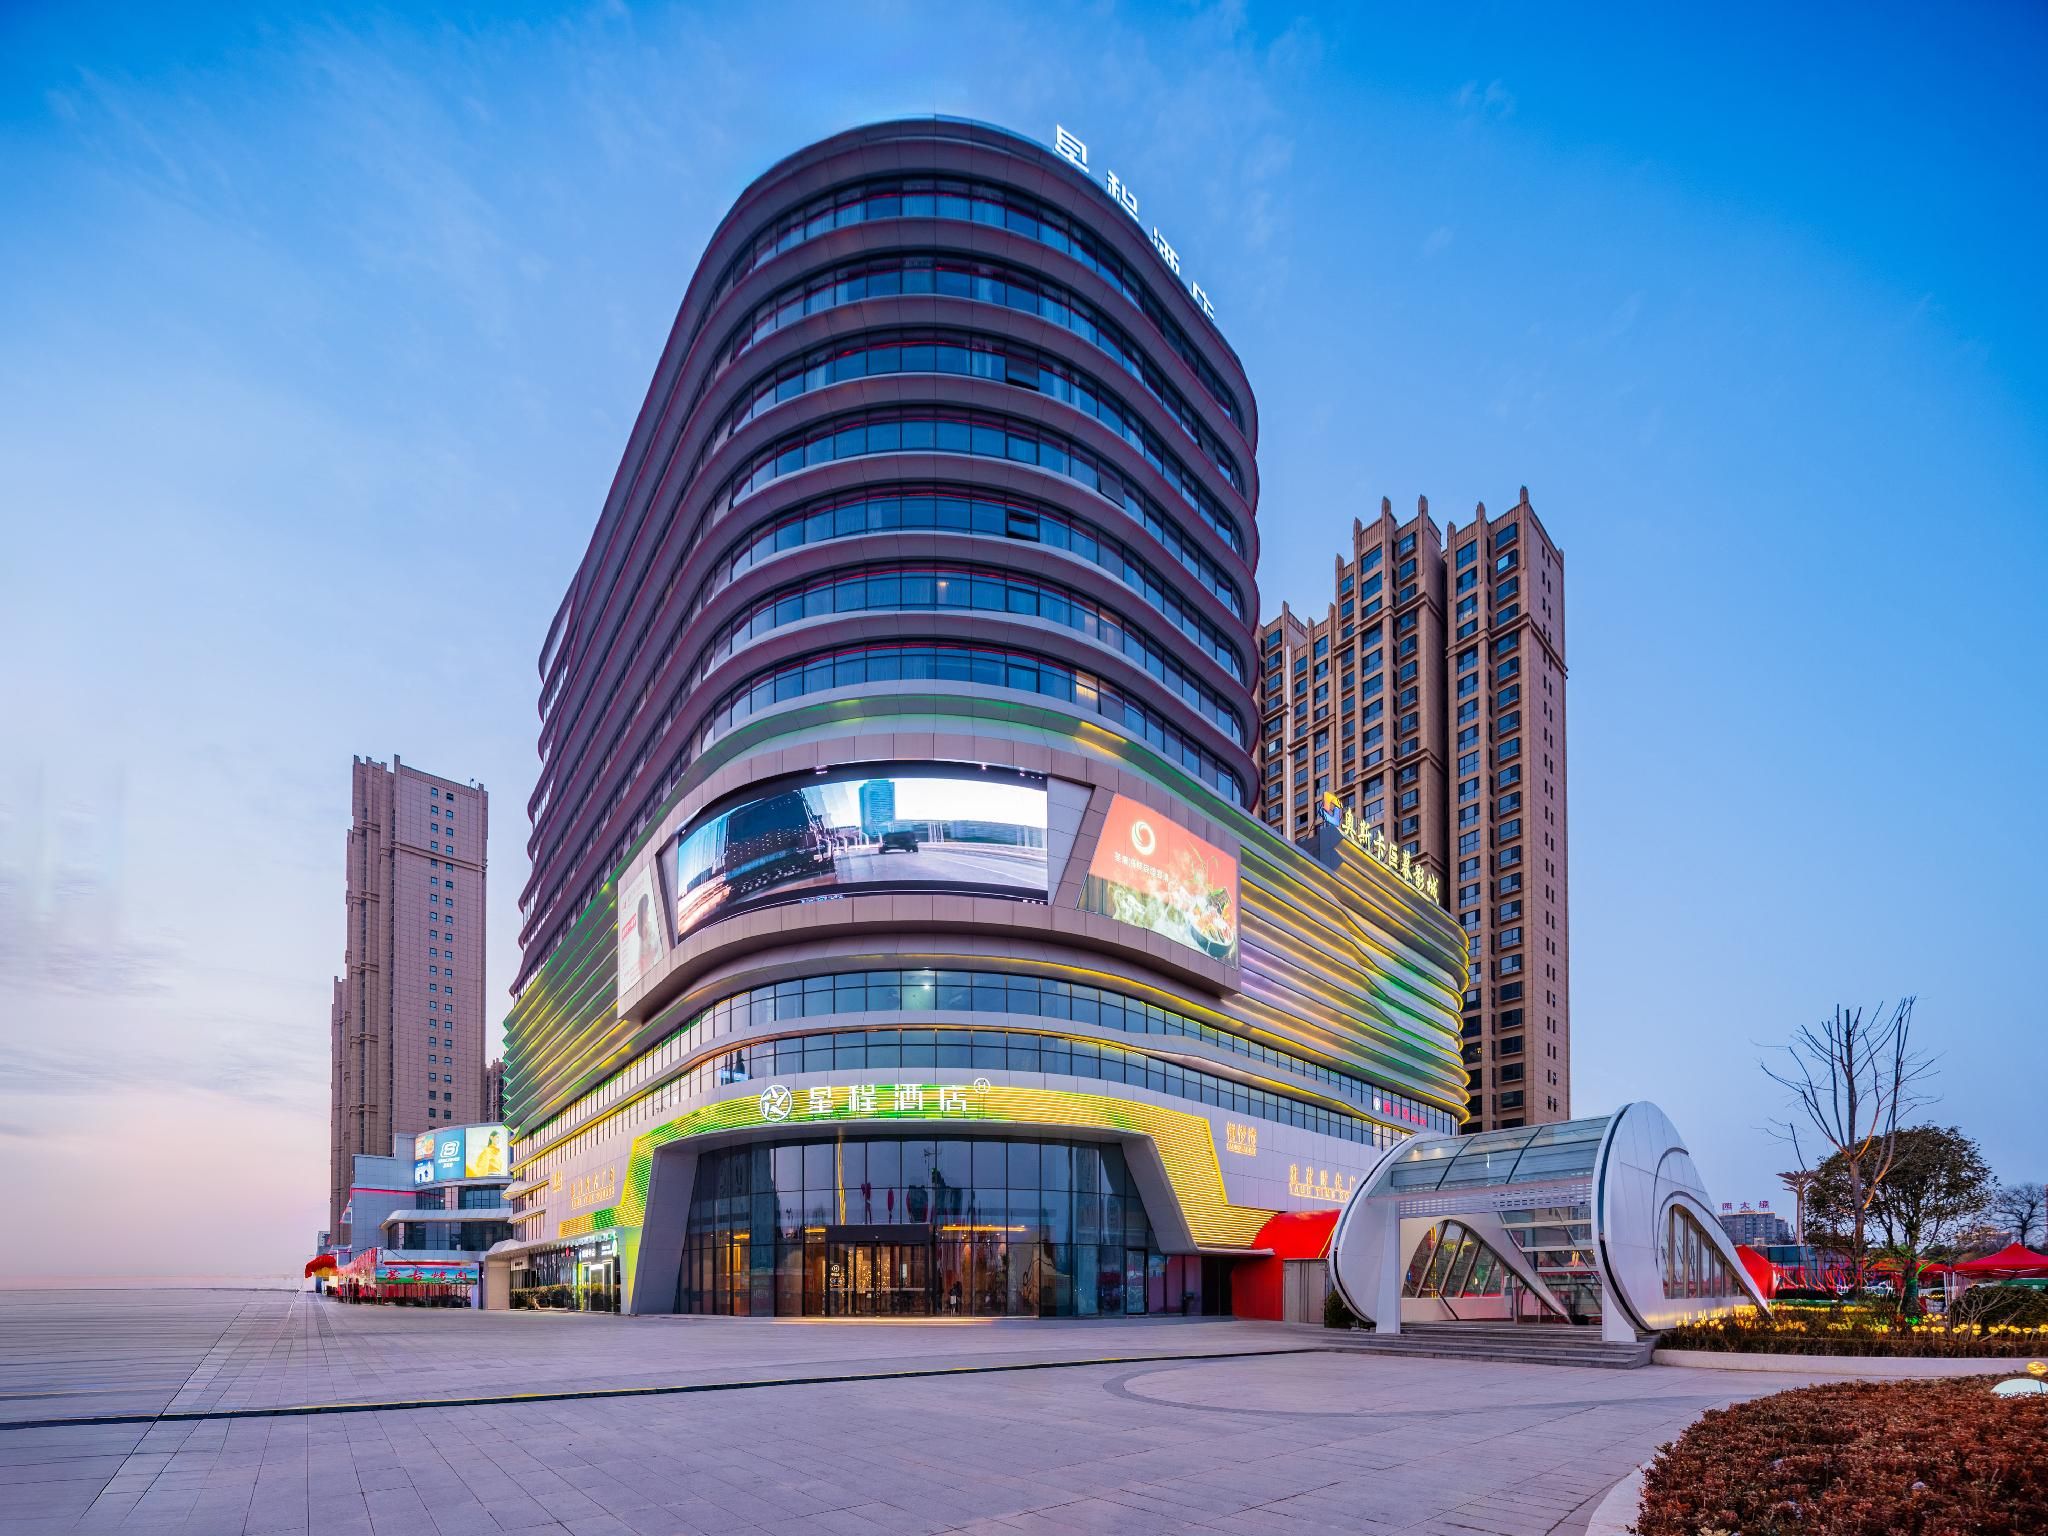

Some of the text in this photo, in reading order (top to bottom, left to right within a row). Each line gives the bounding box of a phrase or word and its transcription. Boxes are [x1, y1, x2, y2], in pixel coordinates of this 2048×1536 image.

[1342, 807, 1440, 905] 奥斯卡巨幕影城
[809, 1084, 967, 1114] 星程酒店
